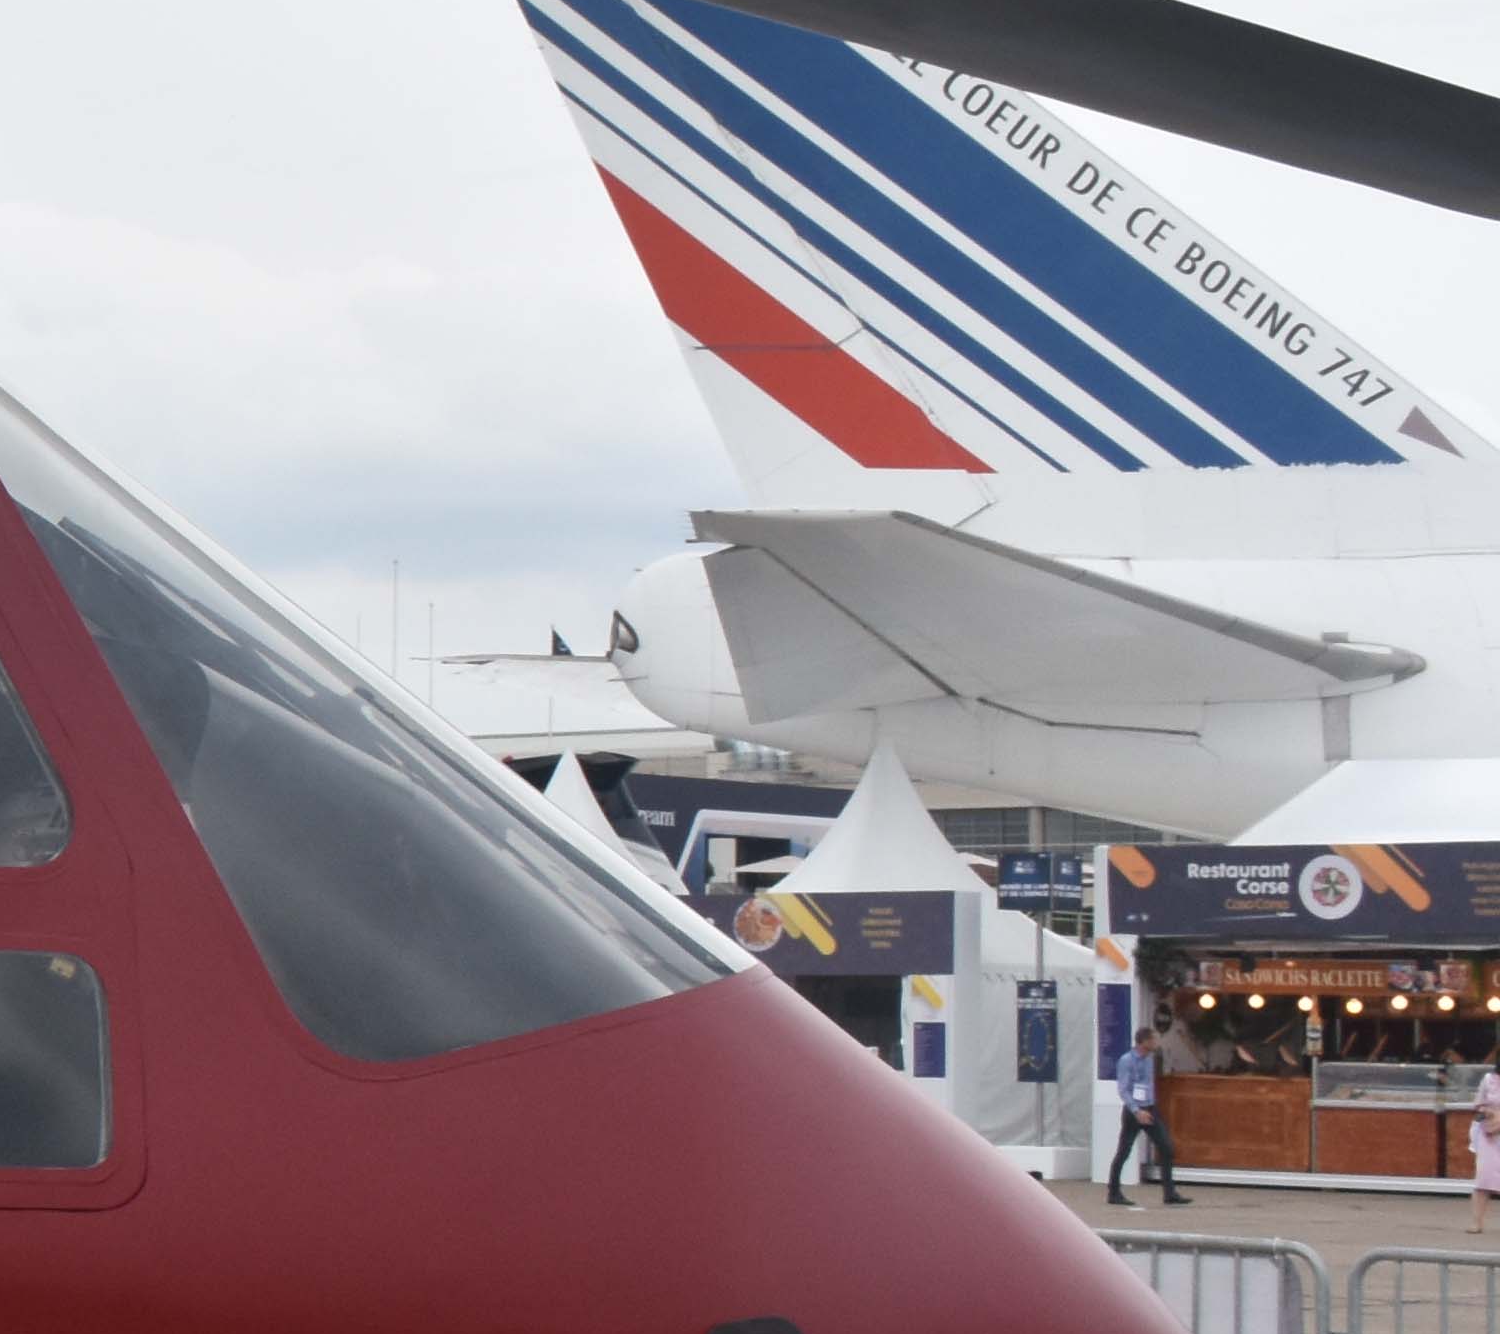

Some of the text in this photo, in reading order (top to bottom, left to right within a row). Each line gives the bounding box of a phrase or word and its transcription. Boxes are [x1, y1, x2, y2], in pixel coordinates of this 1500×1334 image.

[942, 70, 1062, 170] COEUR
[1066, 160, 1125, 215] DE
[1125, 207, 1177, 254] CE
[1174, 241, 1316, 357] BOEING
[1317, 347, 1395, 407] 747
[1187, 862, 1290, 879] Restaurant
[1236, 879, 1290, 895] Corse
[1311, 969, 1384, 987] RACLETTE
